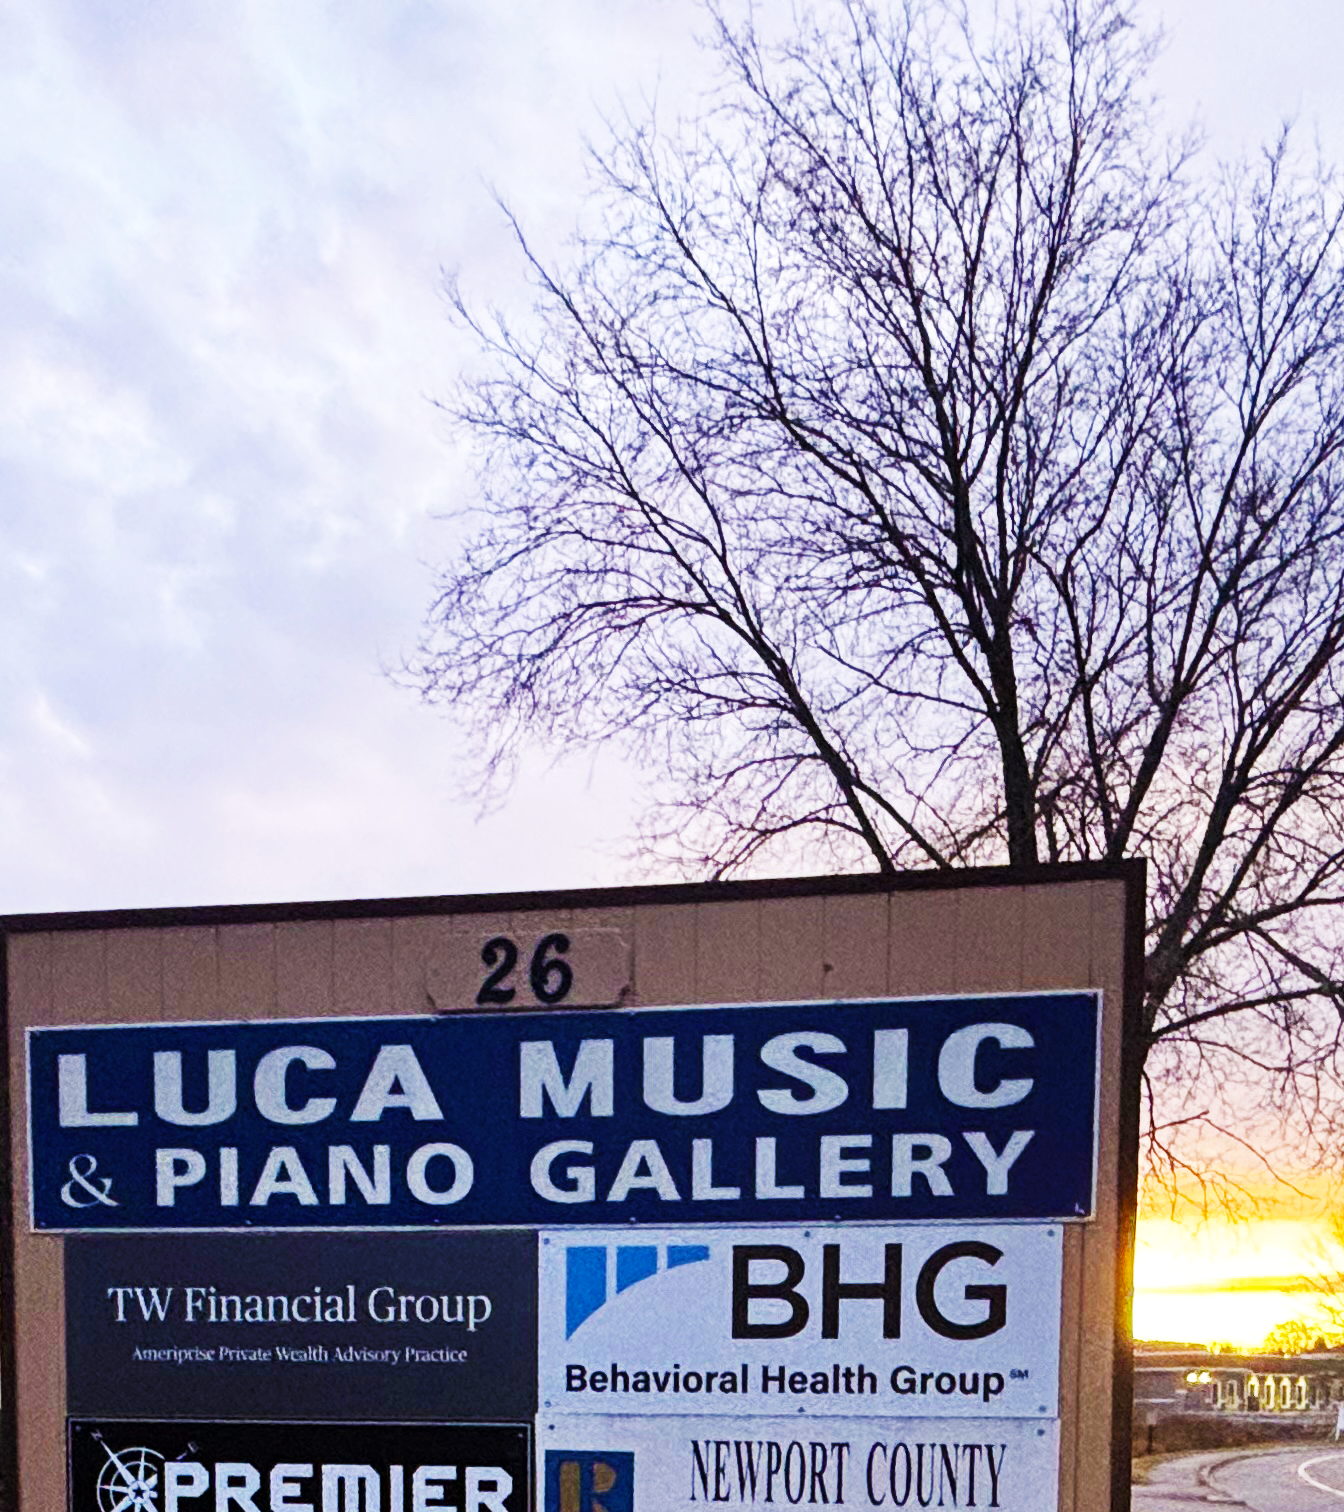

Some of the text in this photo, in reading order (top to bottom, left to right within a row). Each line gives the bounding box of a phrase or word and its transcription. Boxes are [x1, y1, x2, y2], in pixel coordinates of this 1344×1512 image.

[476, 933, 574, 1004] 26
[58, 1023, 1035, 1128] LUCA MUSIC
[60, 1130, 1034, 1207] & PIANO GALLERY
[108, 1285, 493, 1332] TW Financial Group
[731, 1240, 1007, 1340] BHG
[132, 1345, 468, 1366] Ameriprise Private Wealth Advisory Practice
[565, 1364, 749, 1393] Behavioral
[761, 1365, 878, 1394] Health
[890, 1366, 1005, 1402] Group
[689, 1439, 1008, 1508] NEWPORT COUNTY
